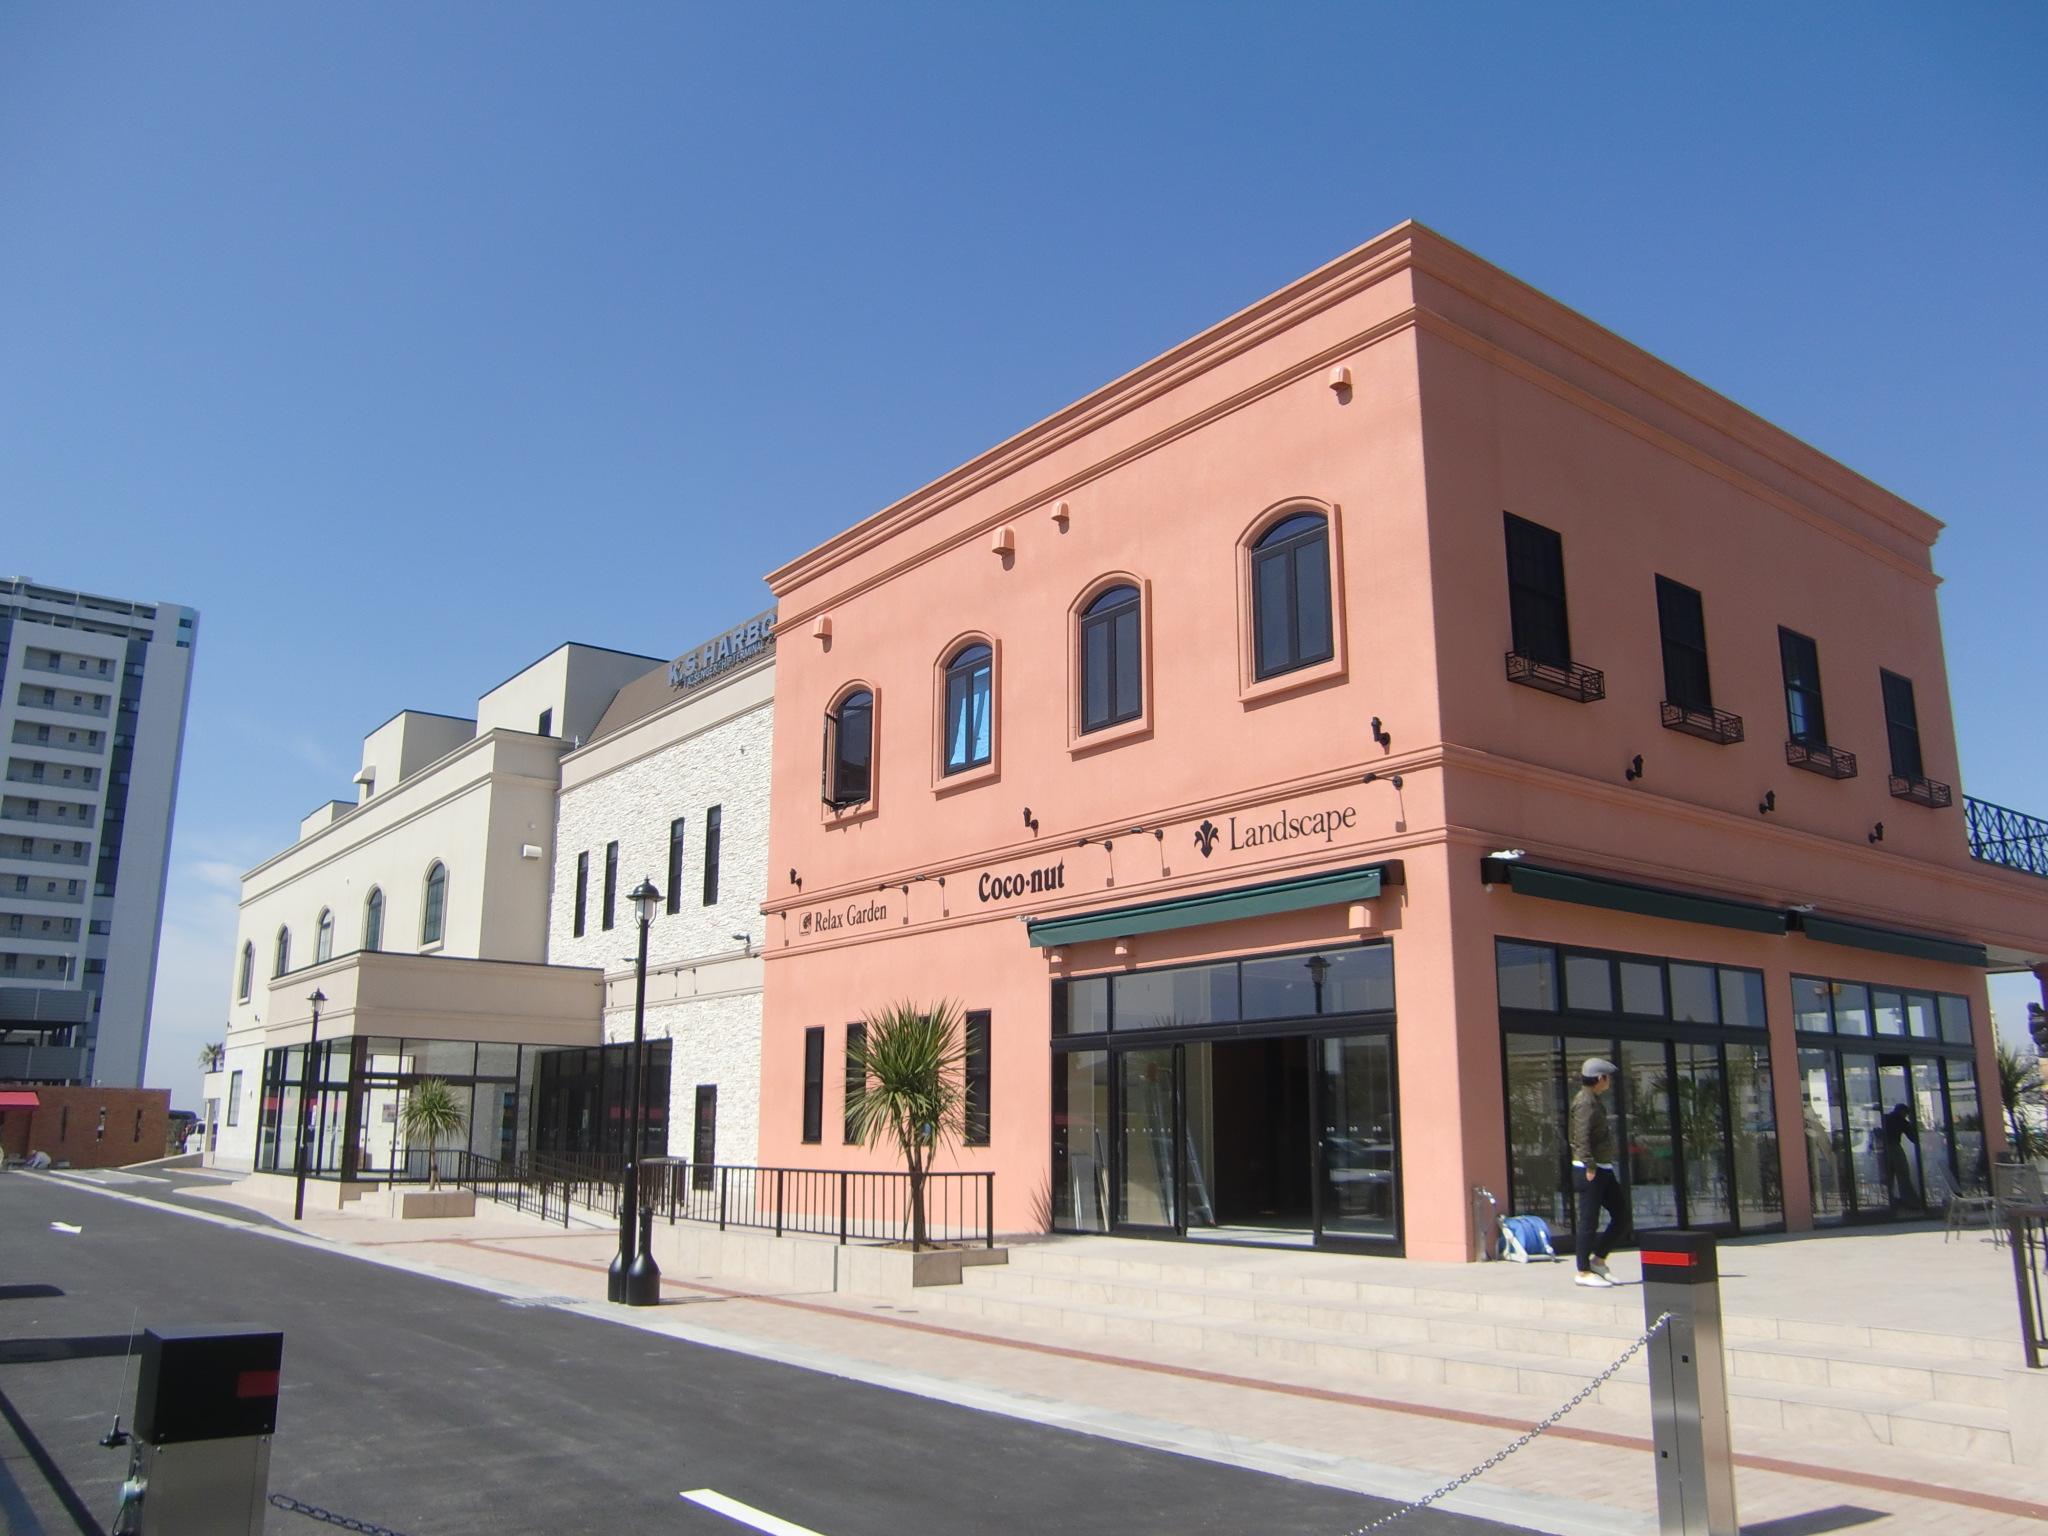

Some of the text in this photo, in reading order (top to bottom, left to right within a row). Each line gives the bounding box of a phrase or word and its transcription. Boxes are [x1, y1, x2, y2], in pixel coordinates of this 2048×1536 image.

[1229, 806, 1357, 851] Landscape
[814, 899, 887, 932] Relax Garden
